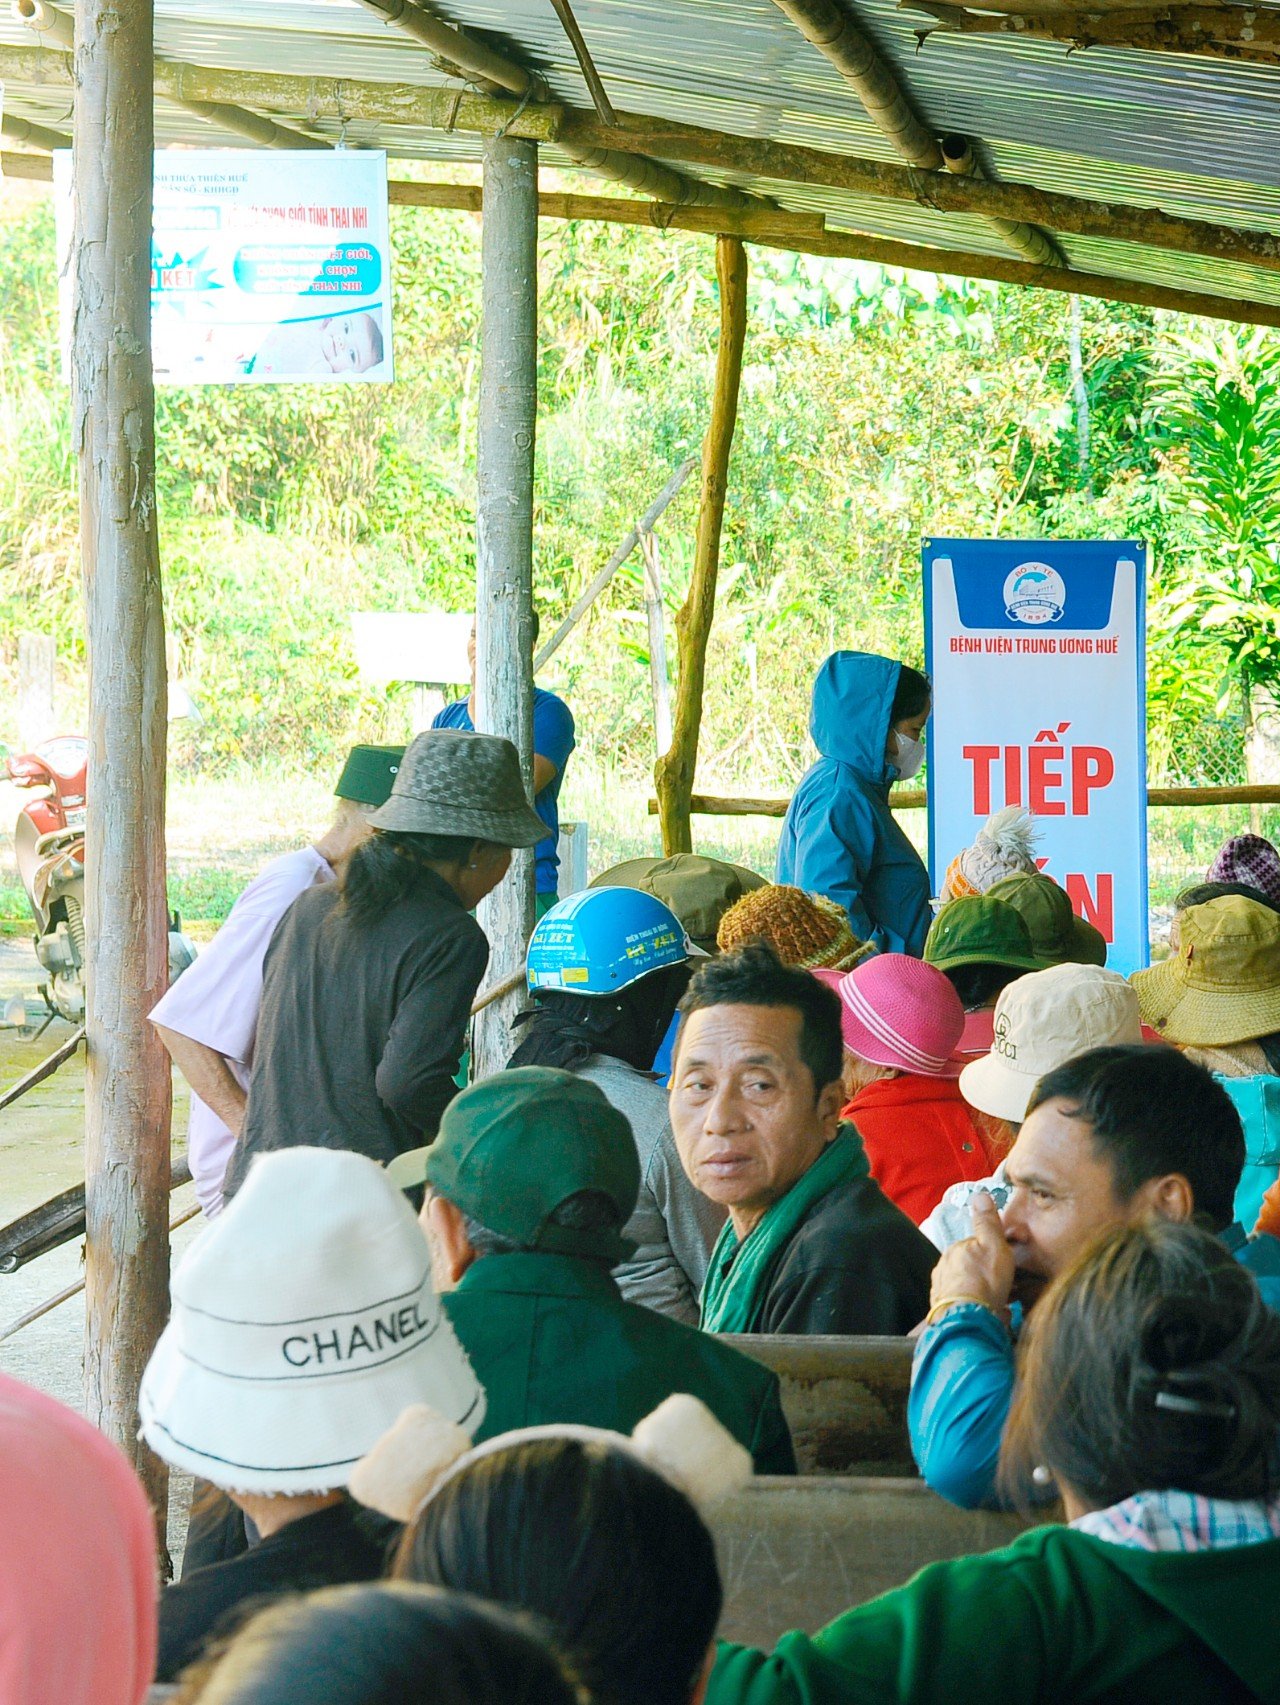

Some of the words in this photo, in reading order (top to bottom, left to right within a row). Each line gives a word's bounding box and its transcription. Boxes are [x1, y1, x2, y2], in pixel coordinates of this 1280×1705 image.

[308, 202, 328, 227] TÍNH
[330, 206, 350, 229] THAI
[352, 206, 368, 229] NHI
[341, 282, 362, 291] NHI
[950, 634, 982, 656] BỆNH
[985, 635, 1013, 656] VIỆN
[1015, 638, 1057, 654] TRUNG
[1059, 637, 1093, 654] ƯƠNG
[1096, 634, 1120, 654] HUẾ
[962, 721, 1115, 816] TIẾP
[282, 1302, 430, 1367] CHANEL
